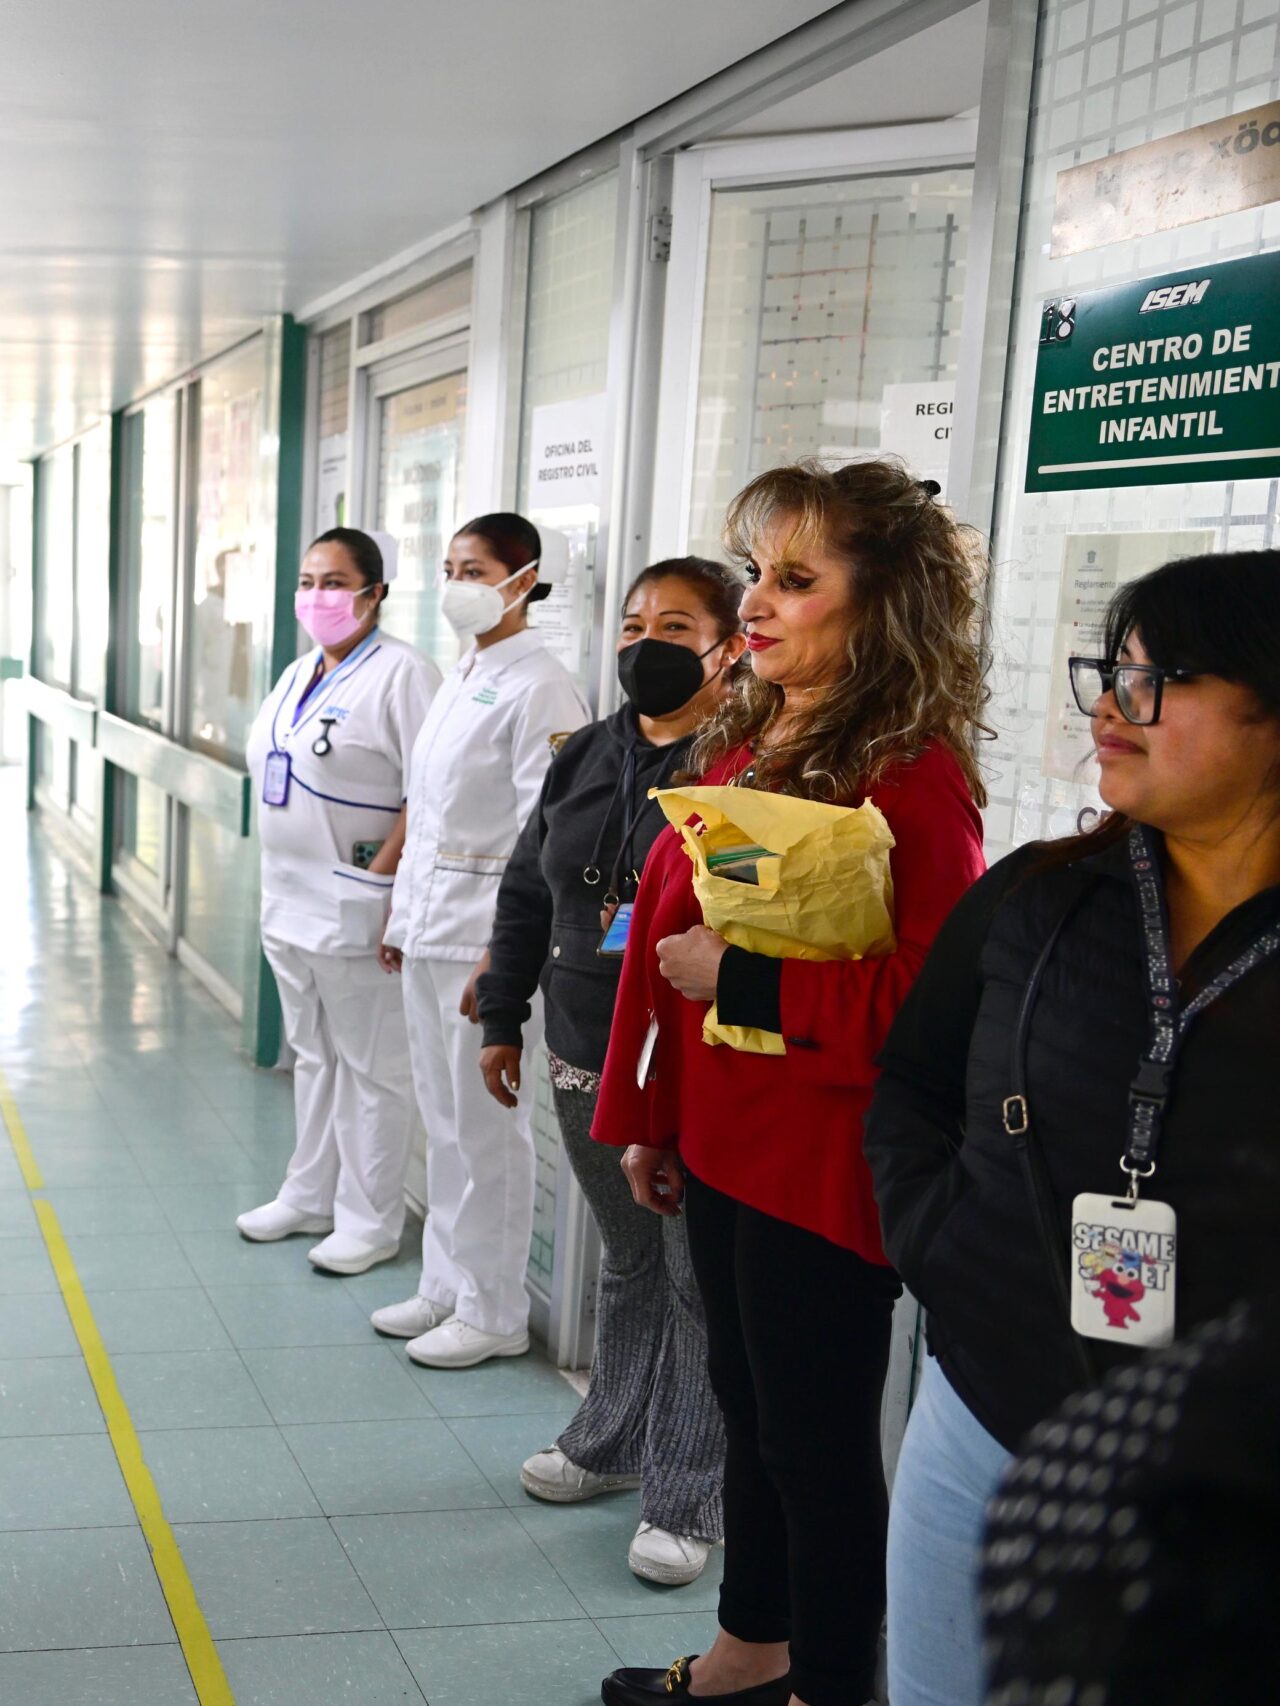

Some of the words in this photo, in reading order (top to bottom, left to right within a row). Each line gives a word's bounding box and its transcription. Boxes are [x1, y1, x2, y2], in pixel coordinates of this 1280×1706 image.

[1138, 279, 1212, 315] ISEM
[1092, 334, 1203, 372] CENTRO
[1212, 324, 1252, 356] DE
[915, 401, 953, 416] REGI
[934, 427, 952, 440] CI
[1099, 410, 1223, 444] INFANTIL
[545, 443, 575, 458] OFICINA
[578, 440, 592, 453] DEL
[538, 466, 574, 482] REGISTRO
[577, 463, 598, 477] CIVIL
[1074, 579, 1116, 590] Reglamento
[1074, 1222, 1175, 1262] SESAME
